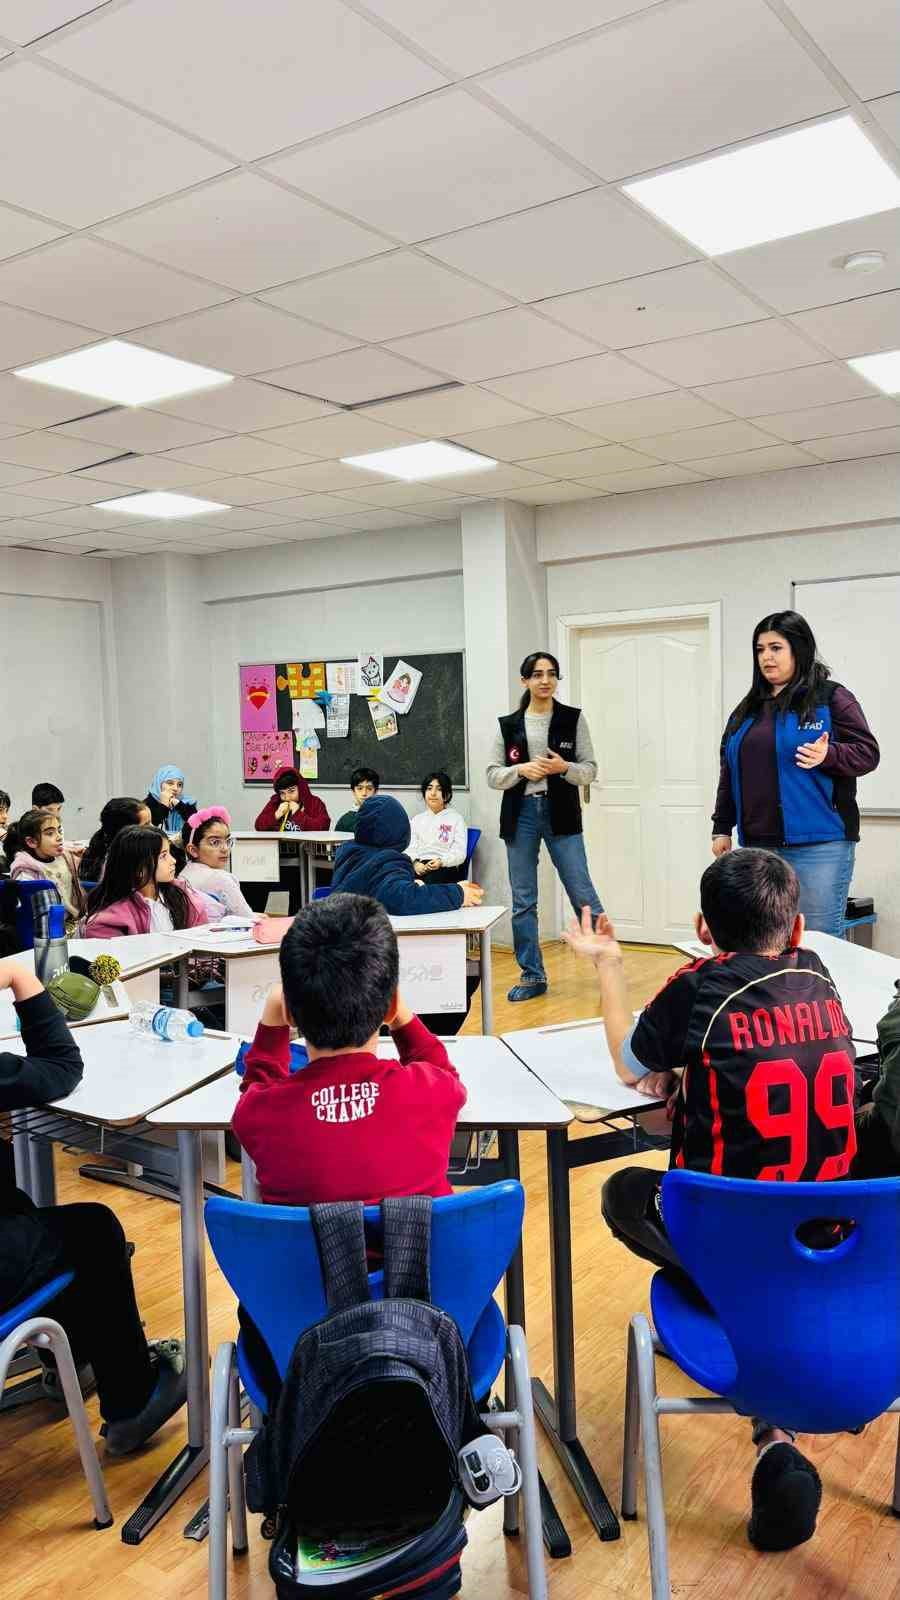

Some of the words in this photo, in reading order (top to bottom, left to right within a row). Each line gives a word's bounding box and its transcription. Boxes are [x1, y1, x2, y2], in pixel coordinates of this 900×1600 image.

[798, 720, 822, 730] FAD
[311, 1081, 380, 1106] COLLEGE
[316, 1097, 376, 1123] CHAMP
[745, 1050, 857, 1182] 99
